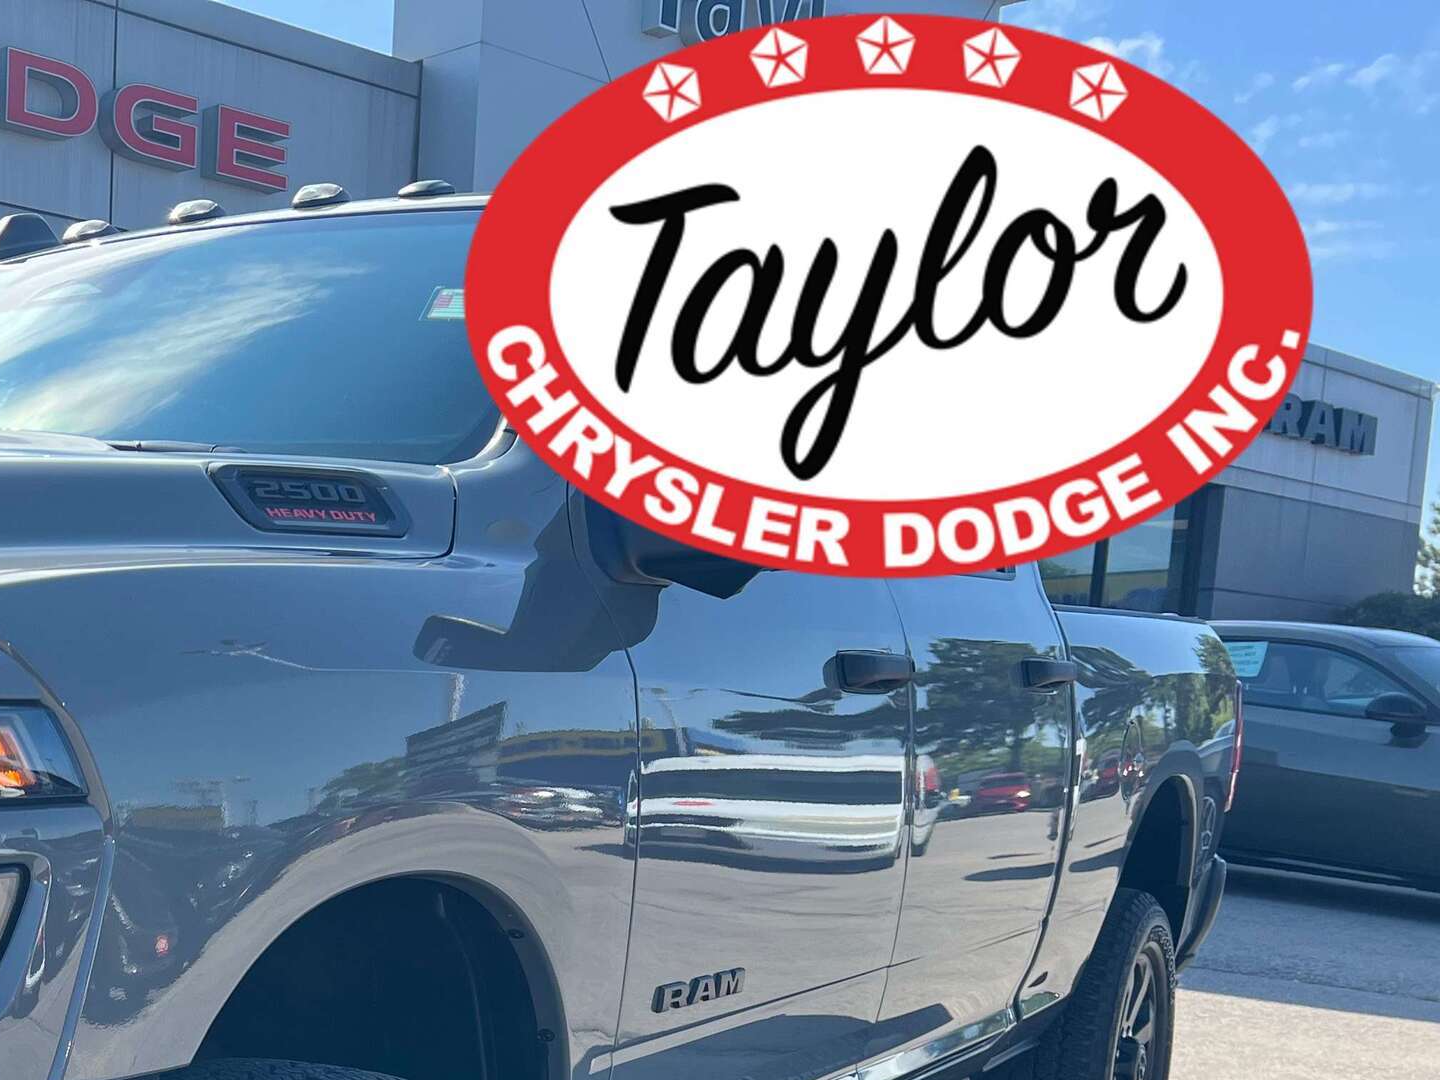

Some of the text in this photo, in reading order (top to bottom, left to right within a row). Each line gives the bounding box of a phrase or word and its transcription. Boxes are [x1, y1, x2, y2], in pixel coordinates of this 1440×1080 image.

[1266, 393, 1378, 456] RAM
[254, 479, 366, 503] 2500
[266, 506, 376, 523] HEAVY DUTY
[651, 967, 746, 1014] RAM
